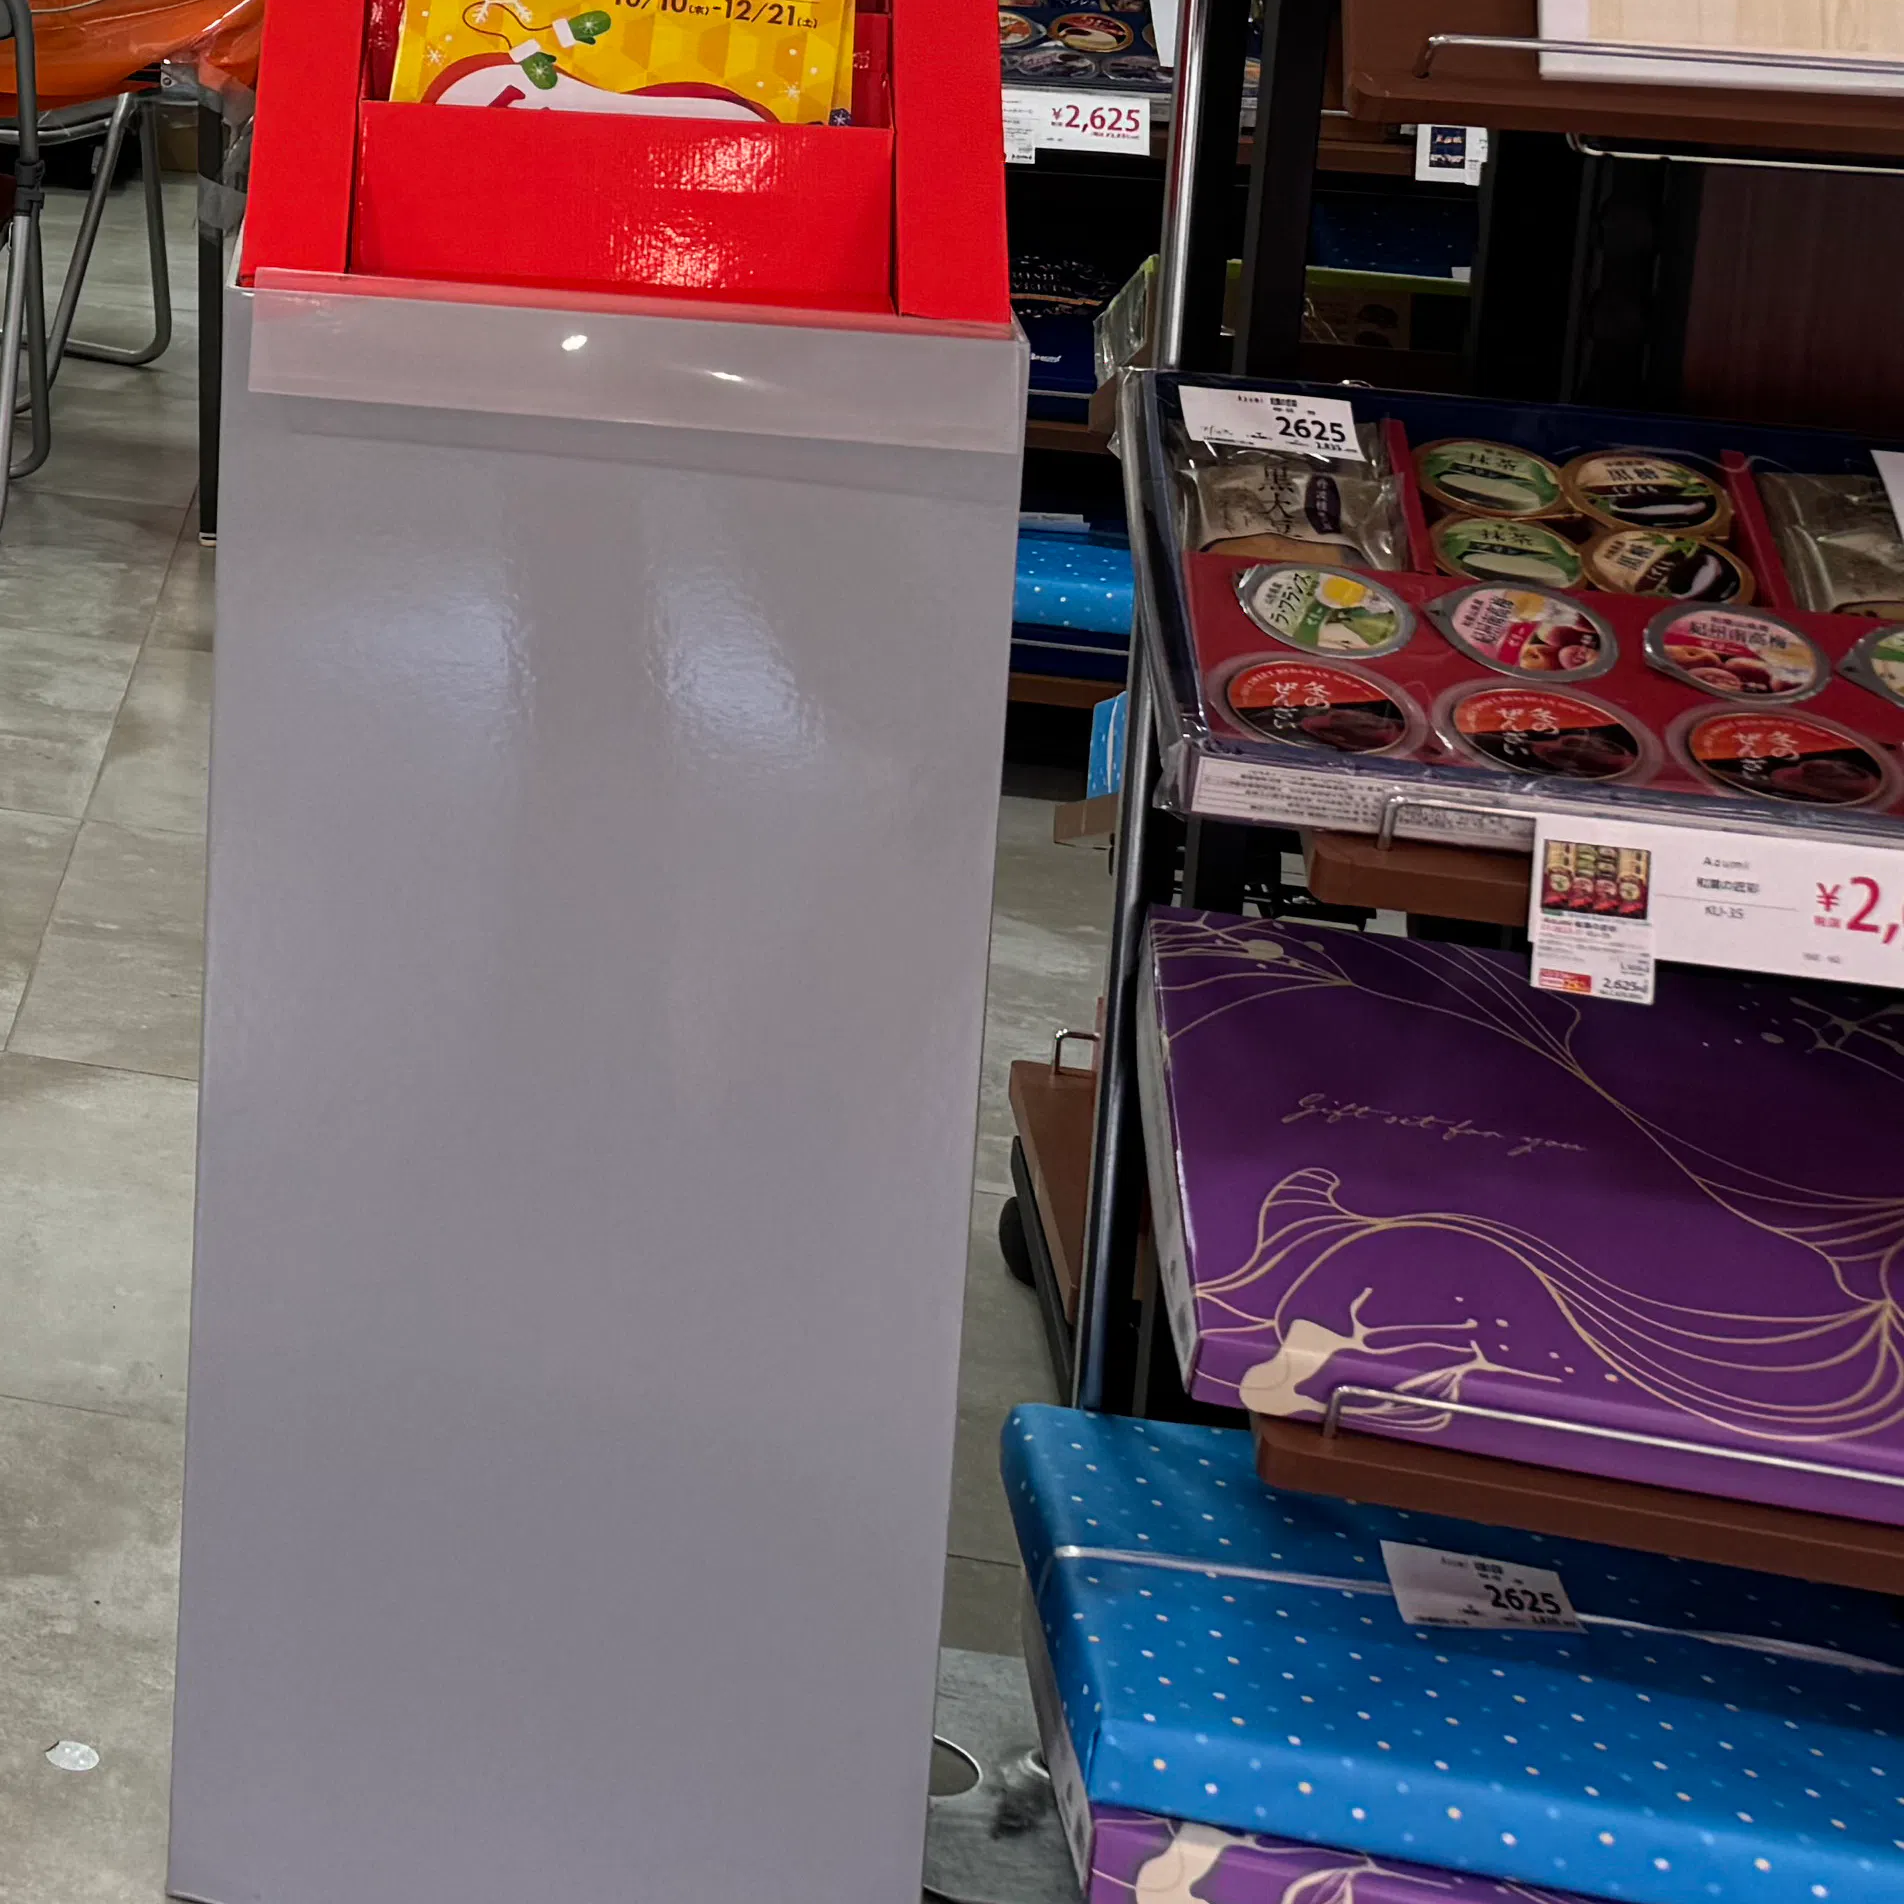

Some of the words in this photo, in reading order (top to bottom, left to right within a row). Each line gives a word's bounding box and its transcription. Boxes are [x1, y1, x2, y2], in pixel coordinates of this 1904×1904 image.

[1052, 104, 1140, 134] ¥2,625
[1275, 416, 1346, 443] 2625
[1282, 1092, 1371, 1124] Gift
[1384, 1112, 1438, 1132] set
[1443, 1116, 1503, 1143] for
[1508, 1133, 1587, 1156] you
[1484, 1584, 1561, 1615] 2625
